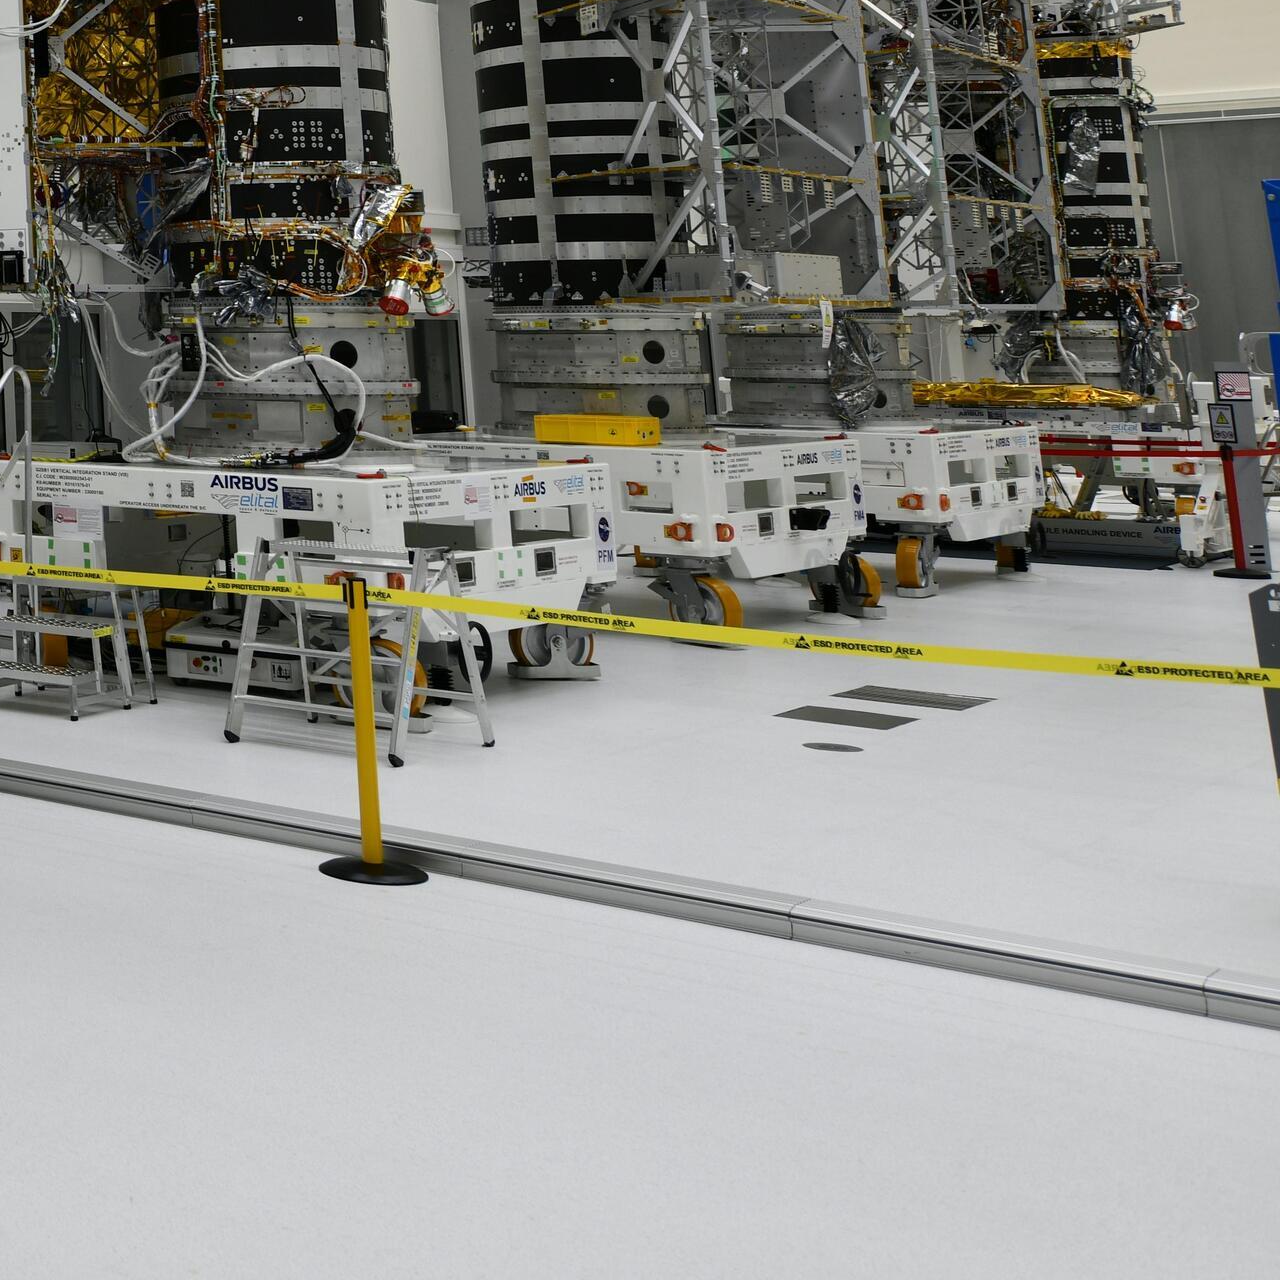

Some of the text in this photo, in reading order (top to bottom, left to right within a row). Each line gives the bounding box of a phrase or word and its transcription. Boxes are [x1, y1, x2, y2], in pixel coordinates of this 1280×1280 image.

[797, 452, 818, 465] AIRBUS
[210, 474, 278, 492] AIRBUS
[514, 481, 546, 497] AIRBUS
[240, 493, 279, 509] elital
[1062, 528, 1143, 538] HANDLING DEVICE
[598, 549, 614, 563] PFM
[230, 583, 271, 592] PROTECTED
[372, 591, 392, 600] AREA
[542, 611, 635, 628] ESD PROTECTED AREA
[813, 640, 923, 656] ESD PROTECTED AREA
[1137, 666, 1271, 682] ESD PROTECTED AREA
